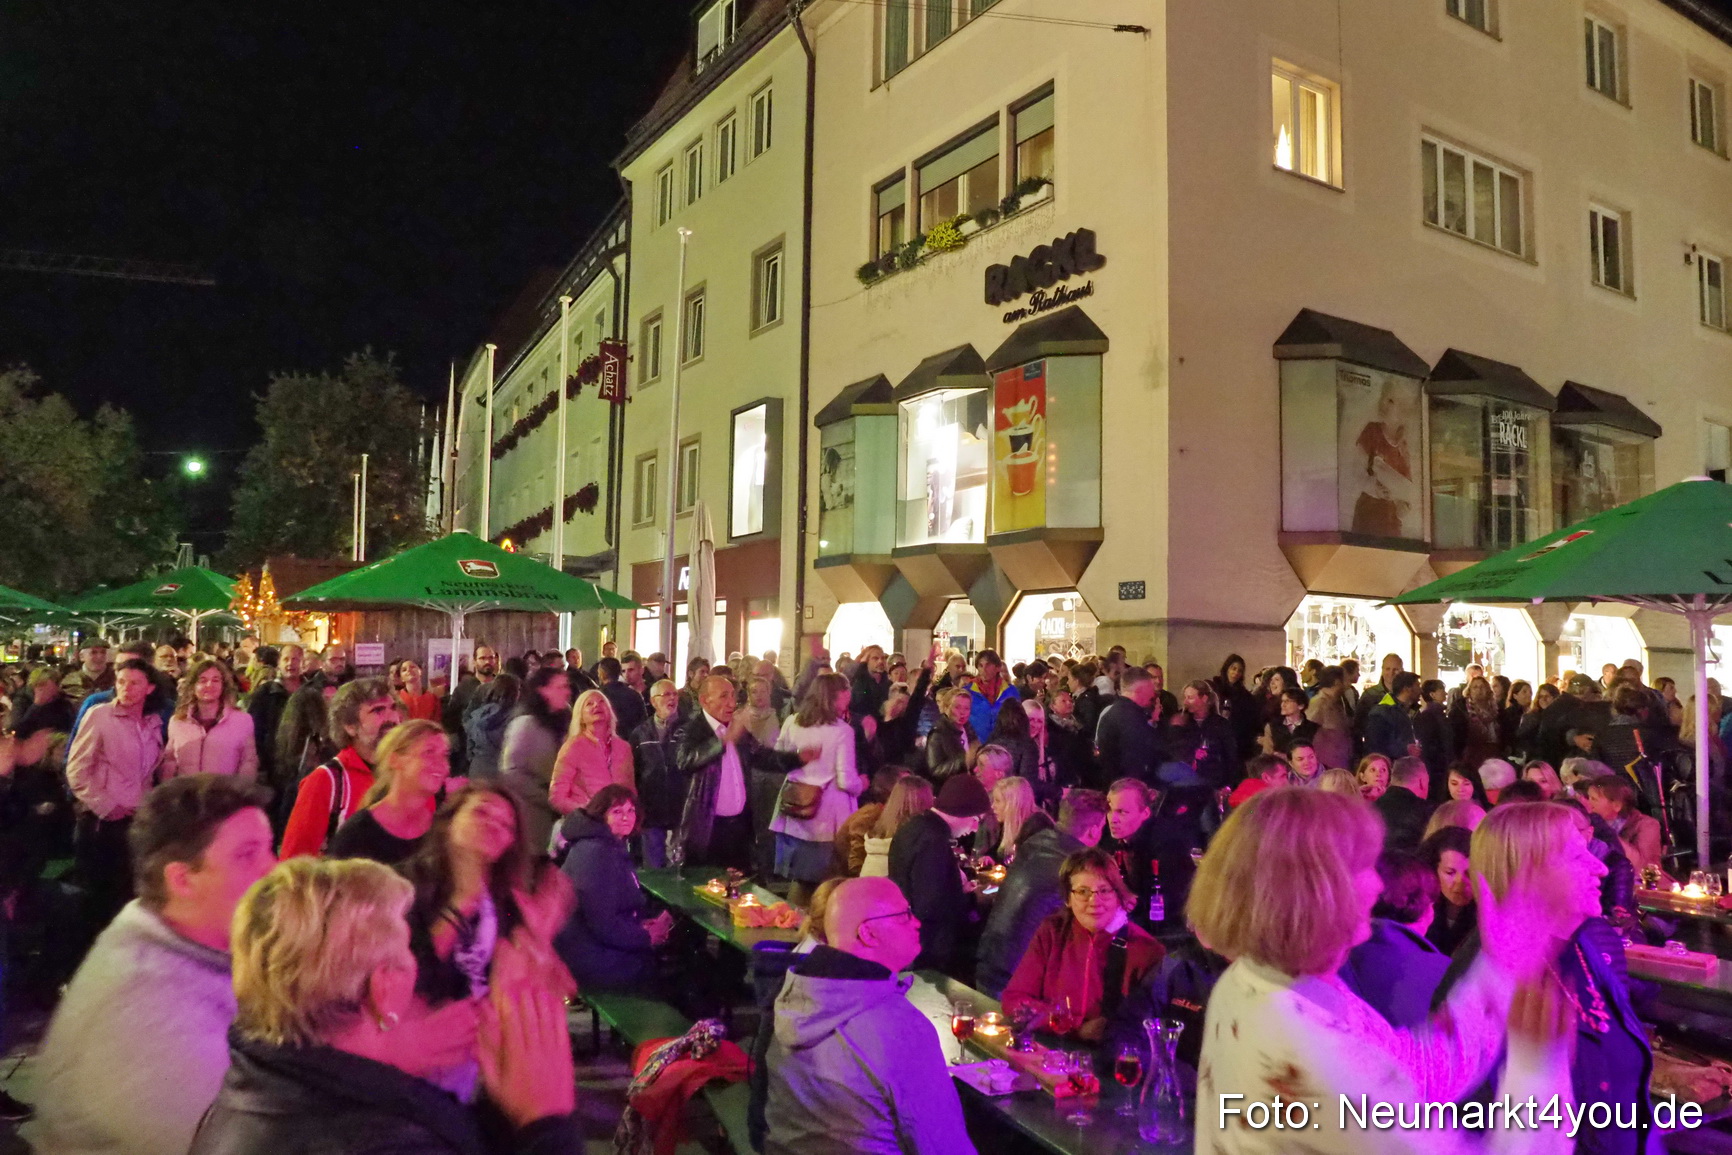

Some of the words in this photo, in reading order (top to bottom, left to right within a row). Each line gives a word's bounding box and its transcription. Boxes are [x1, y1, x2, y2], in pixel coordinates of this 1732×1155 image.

[1028, 279, 1094, 315] Rathaus
[604, 351, 619, 397] Achatz
[1500, 421, 1528, 449] RACKL
